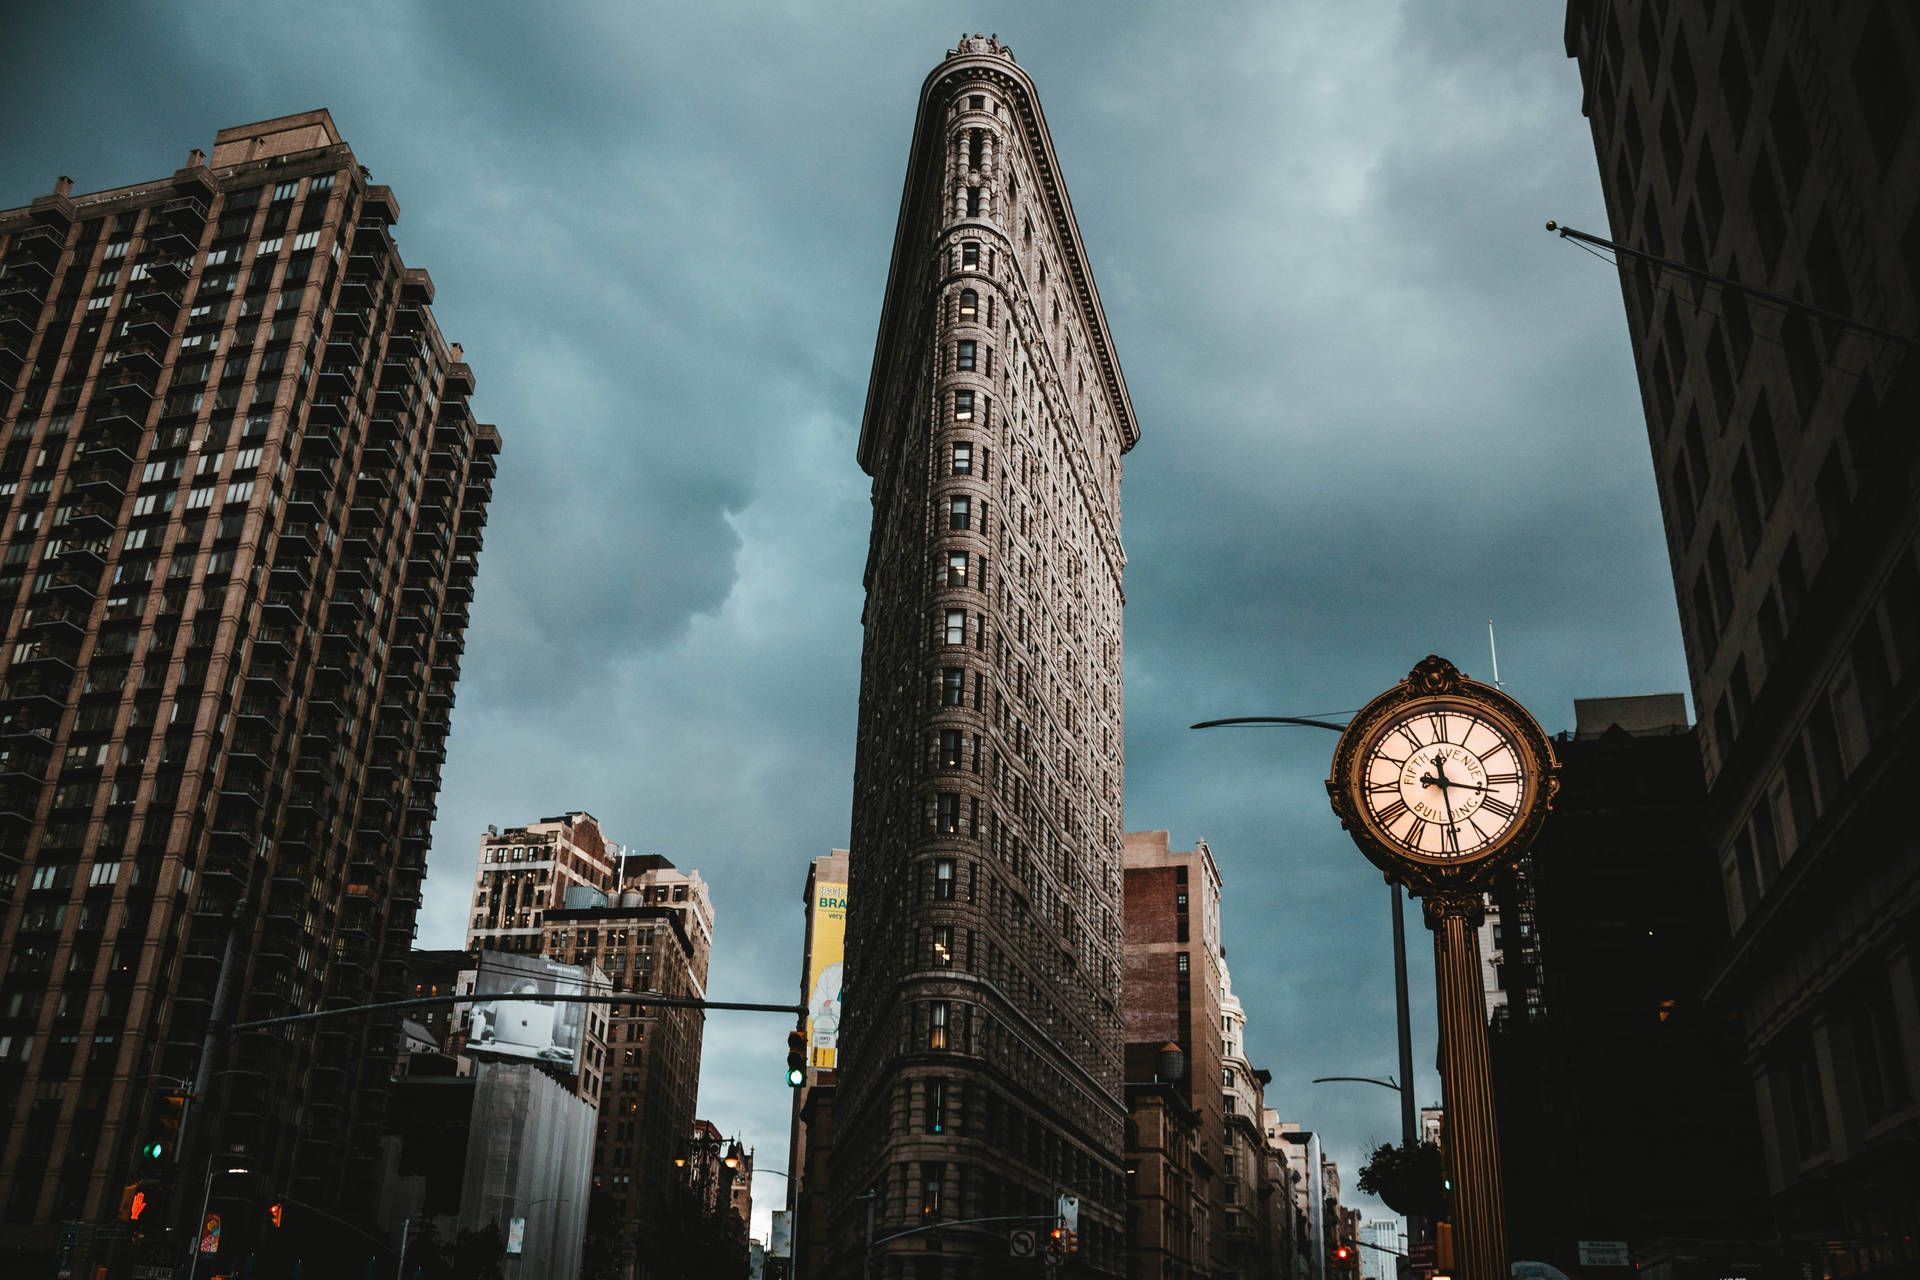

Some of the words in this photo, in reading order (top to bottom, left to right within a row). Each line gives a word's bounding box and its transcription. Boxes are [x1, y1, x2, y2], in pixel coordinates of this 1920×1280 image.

[1399, 724, 1424, 752] XI
[1430, 715, 1448, 743] XII
[1375, 750, 1405, 770] X
[1478, 742, 1505, 762] II
[1404, 753, 1430, 785] FIFTH
[1438, 748, 1482, 779] AVENUE
[1487, 774, 1518, 785] III
[1414, 798, 1478, 821] BUILDING
[828, 912, 843, 920] very
